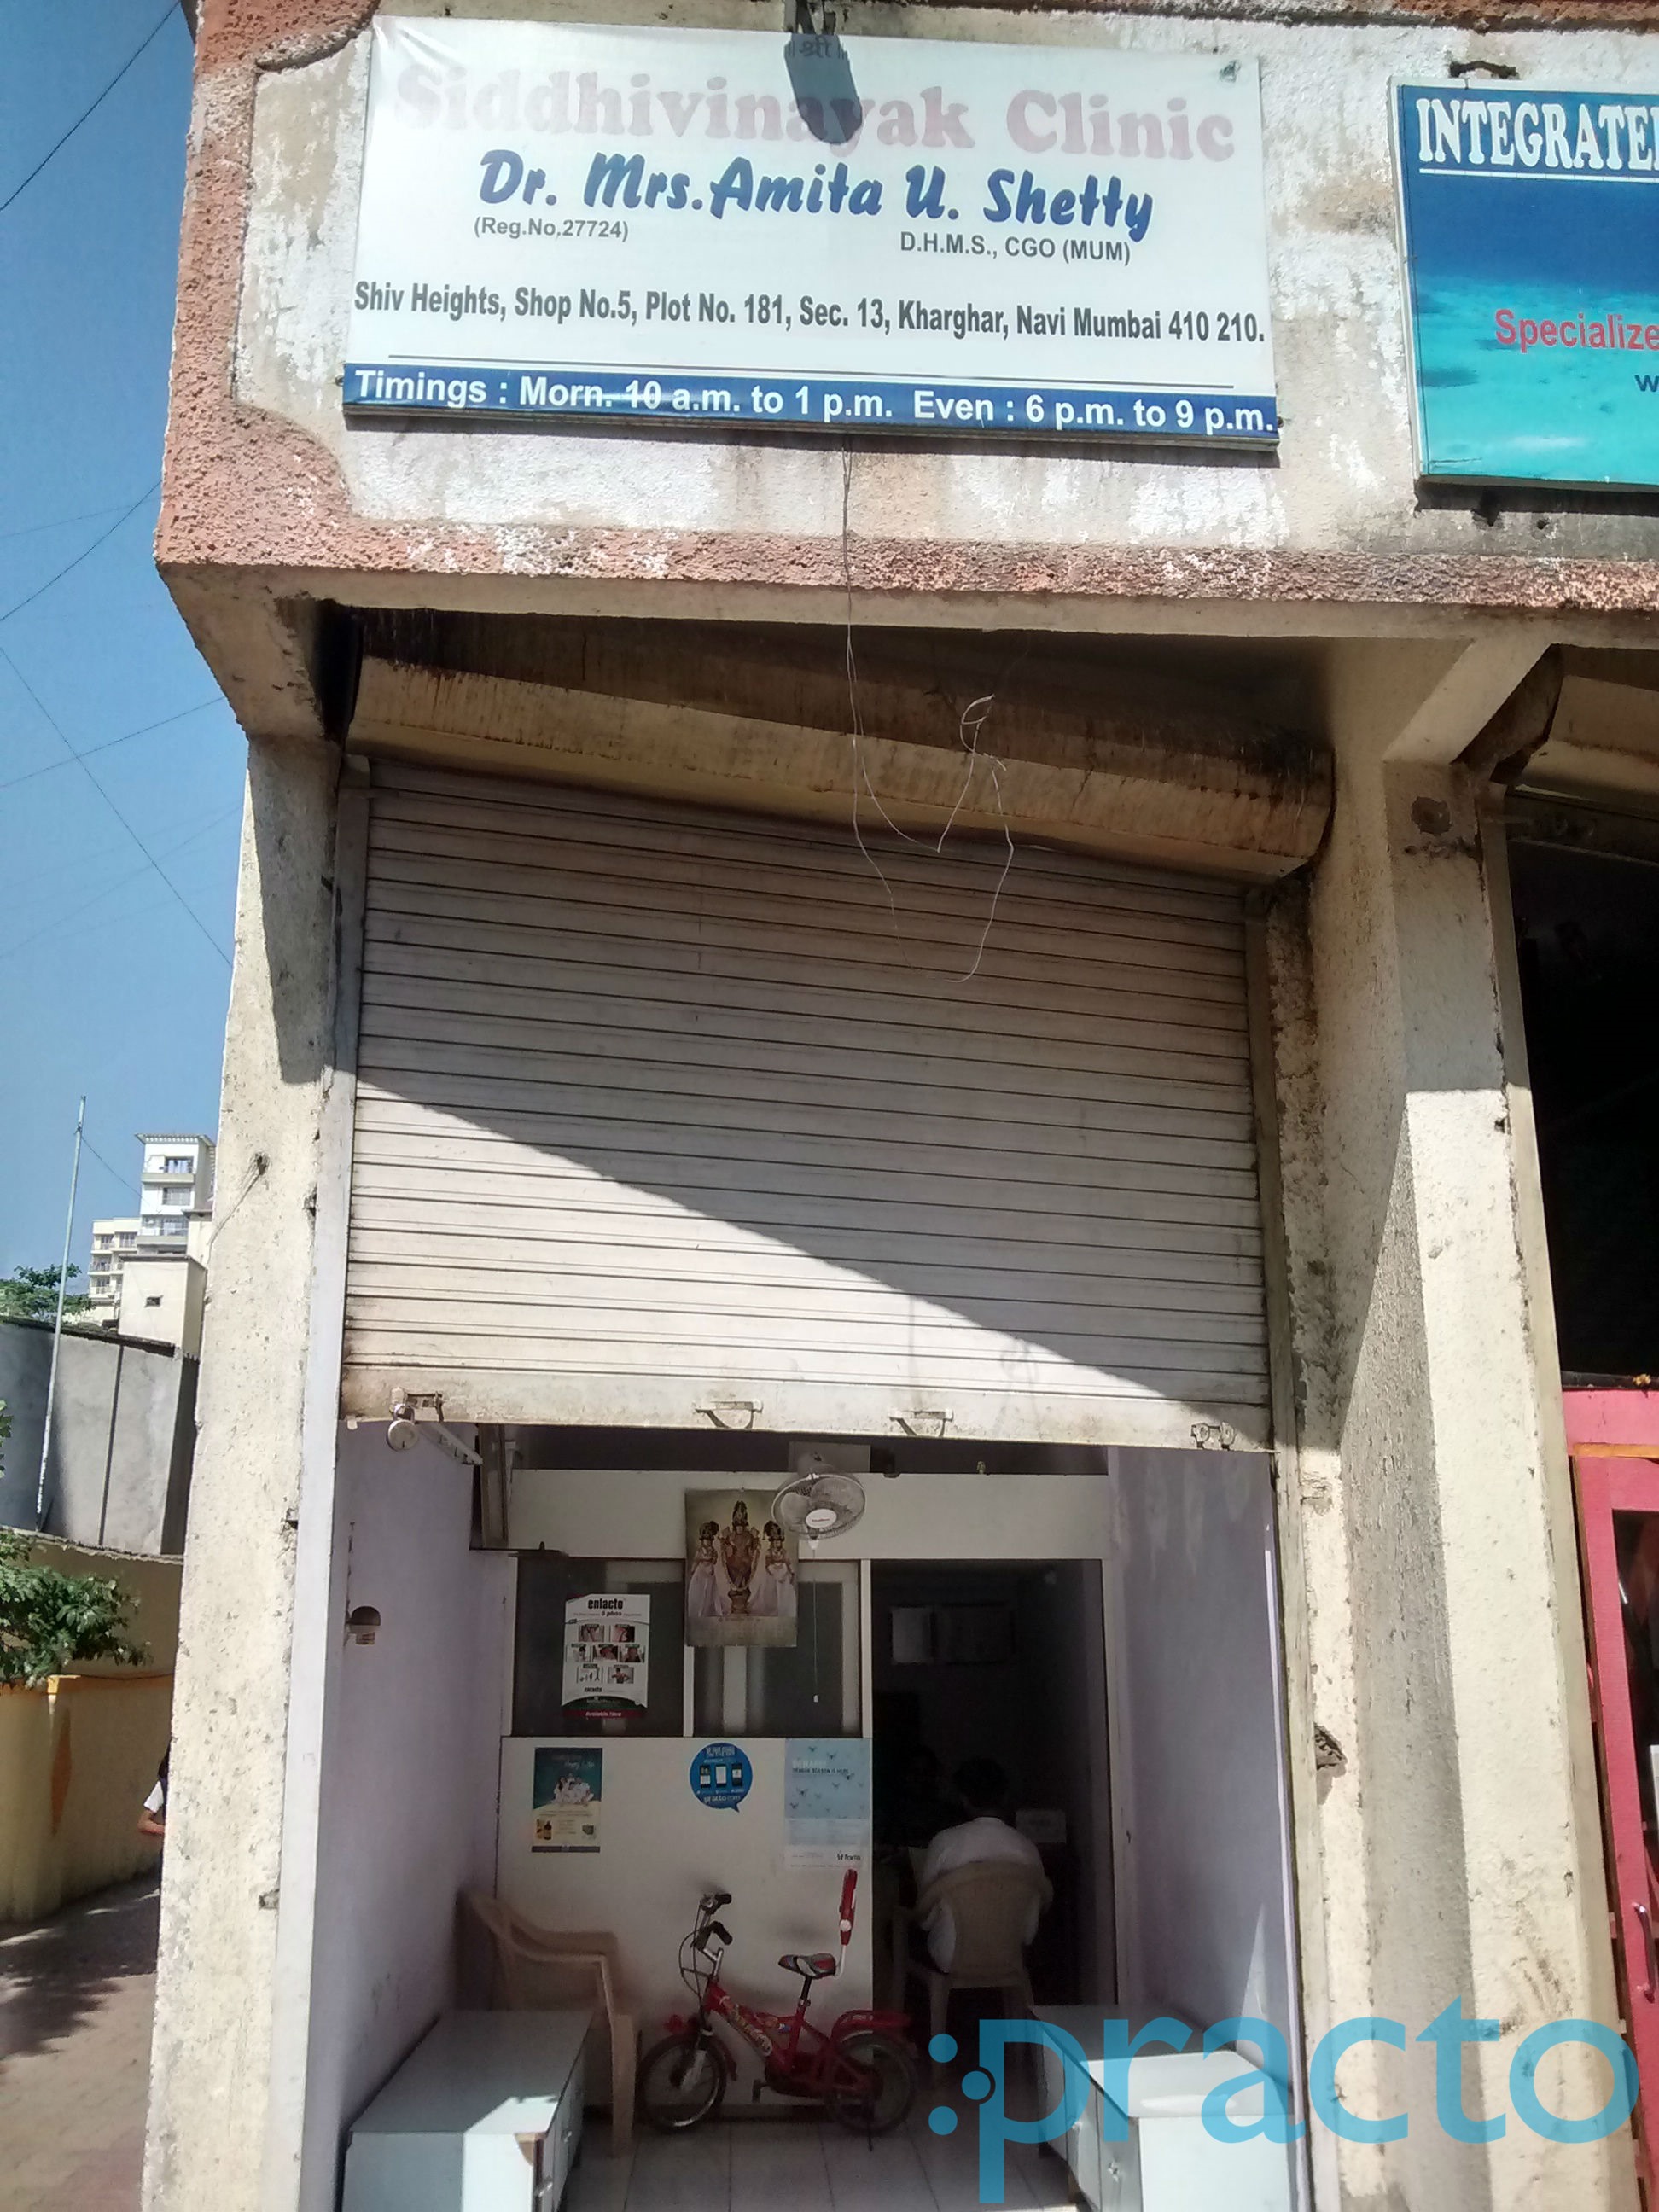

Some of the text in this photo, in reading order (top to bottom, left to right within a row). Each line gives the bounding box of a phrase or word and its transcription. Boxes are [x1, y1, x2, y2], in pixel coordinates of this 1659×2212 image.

[394, 64, 1236, 162] Siddhivinayak Clinic
[479, 148, 558, 207] Dr.
[905, 164, 959, 221] U.
[983, 168, 1153, 242] Shetty
[474, 216, 629, 242] (Reg.No.27724)
[900, 230, 1131, 266] D.H.M.S., CGO (MUM)
[354, 281, 1265, 343] Shiv Heights, Shop No.5, Plot No. 181, Sec. 13, Kharghar, Navi Mumbai 410 210.
[355, 370, 486, 408] Timings
[520, 376, 613, 408] Morn.
[626, 380, 661, 410] 10
[672, 388, 741, 412] a.m.
[751, 387, 784, 414] to
[795, 385, 809, 415] 1
[823, 392, 893, 424] p.m.
[914, 390, 995, 421] Even
[1026, 394, 1045, 423] 6
[1055, 400, 1124, 430] p.m.
[1134, 399, 1166, 428] to
[1175, 399, 1194, 428] 9
[1205, 405, 1274, 434] p.m.
